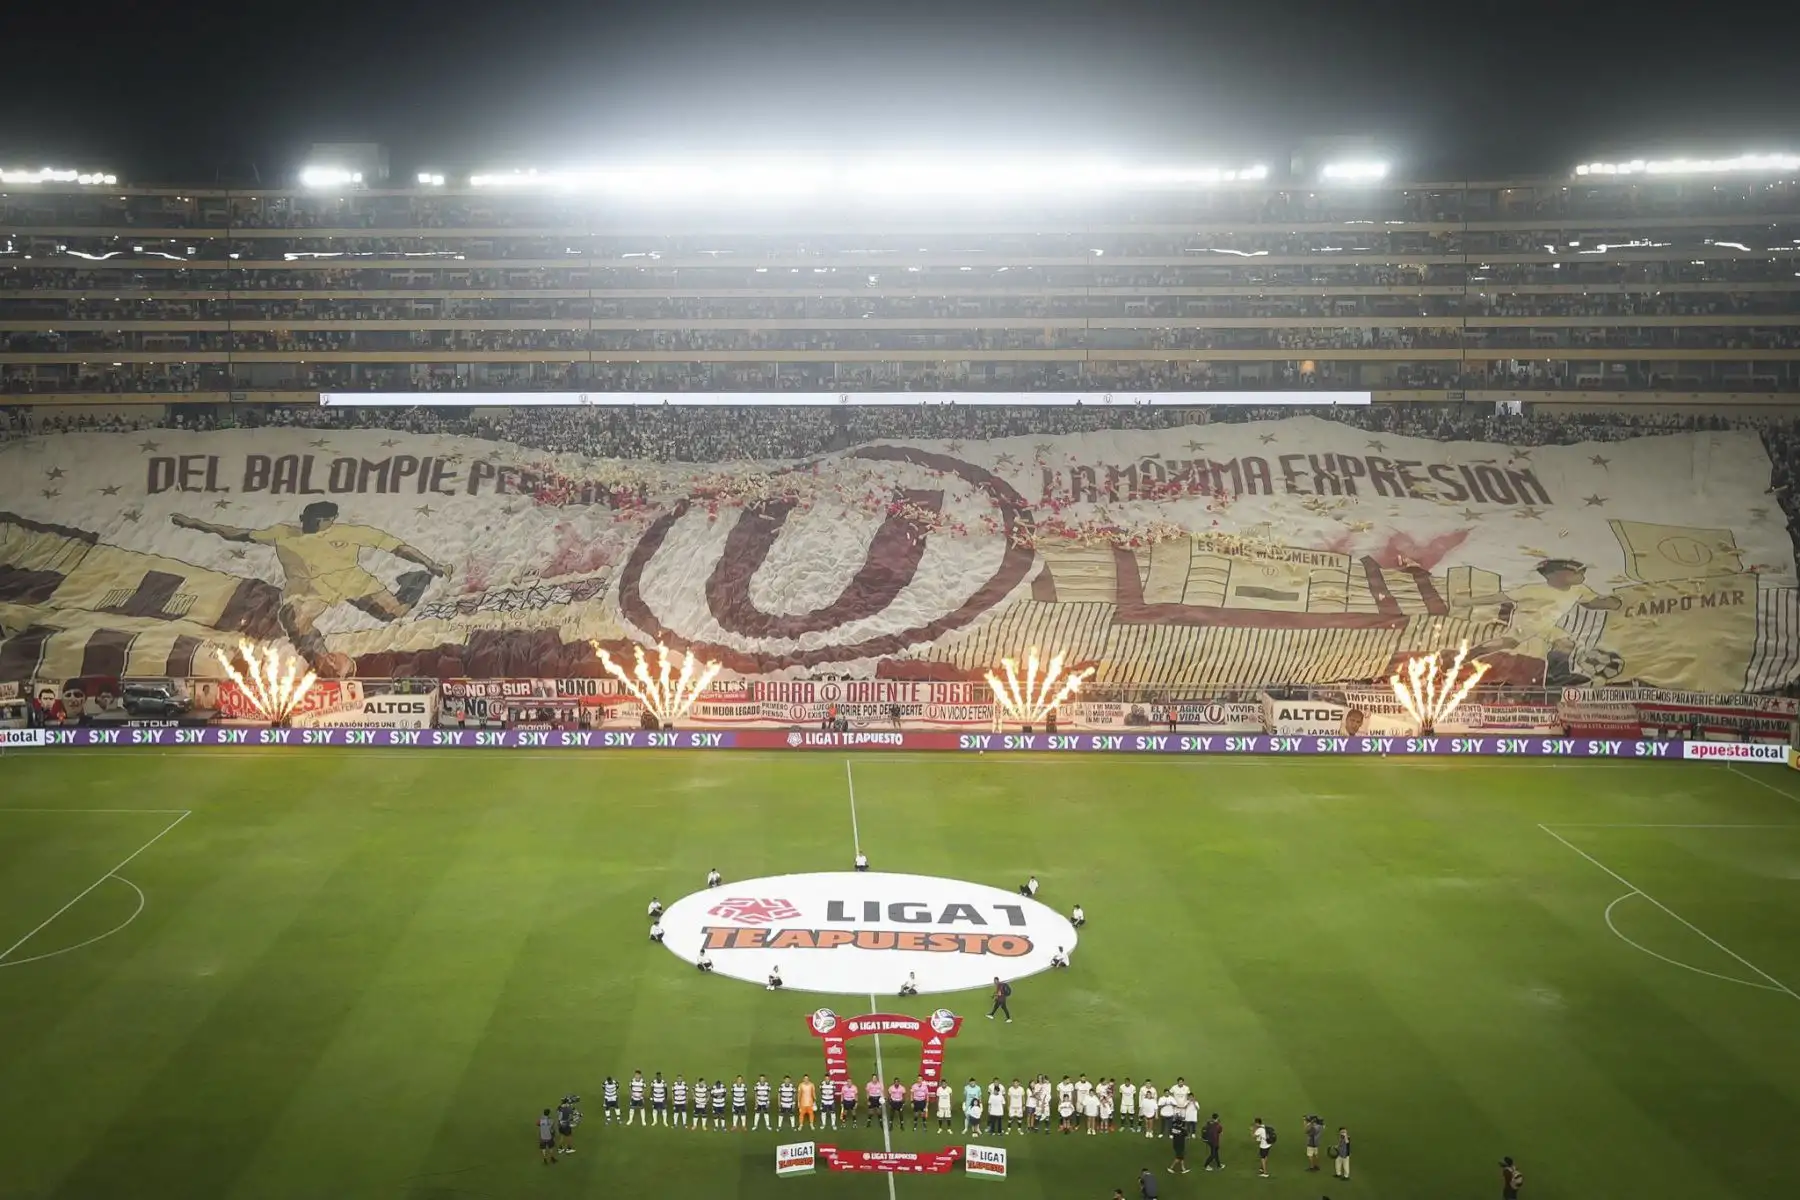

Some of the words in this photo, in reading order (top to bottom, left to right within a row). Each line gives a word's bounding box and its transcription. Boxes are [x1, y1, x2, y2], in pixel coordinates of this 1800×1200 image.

[147, 455, 230, 494] DEL
[244, 453, 456, 495] BALOMPIE
[1042, 464, 1097, 503] LA
[1280, 453, 1554, 505] EXPRESIÓN
[706, 488, 945, 640] U
[1624, 596, 1692, 618] CAMPO
[1700, 590, 1744, 608] MAR
[502, 683, 531, 695] SUR
[557, 680, 597, 696] CONO
[754, 681, 815, 703] BARRA
[846, 681, 921, 702] ORIENTE
[1626, 688, 1671, 702] VOLVEREMOS
[1672, 692, 1688, 703] PARA
[1688, 693, 1714, 706] VERTE
[363, 702, 425, 714] ALTOS
[702, 705, 711, 715] MI
[712, 705, 734, 716] MEJOR
[735, 705, 760, 716] LEGADO
[761, 703, 788, 711] PRIMERO
[863, 704, 875, 716] POR
[947, 705, 967, 720] VICIO
[1151, 705, 1162, 713] EL
[1229, 705, 1255, 713] VIVIR
[1180, 713, 1200, 721] VIDA
[1278, 708, 1344, 721] ALTOS
[121, 719, 179, 728] JETOUR
[334, 720, 363, 728] PASIÓN
[1691, 744, 1784, 758] apuestatotal
